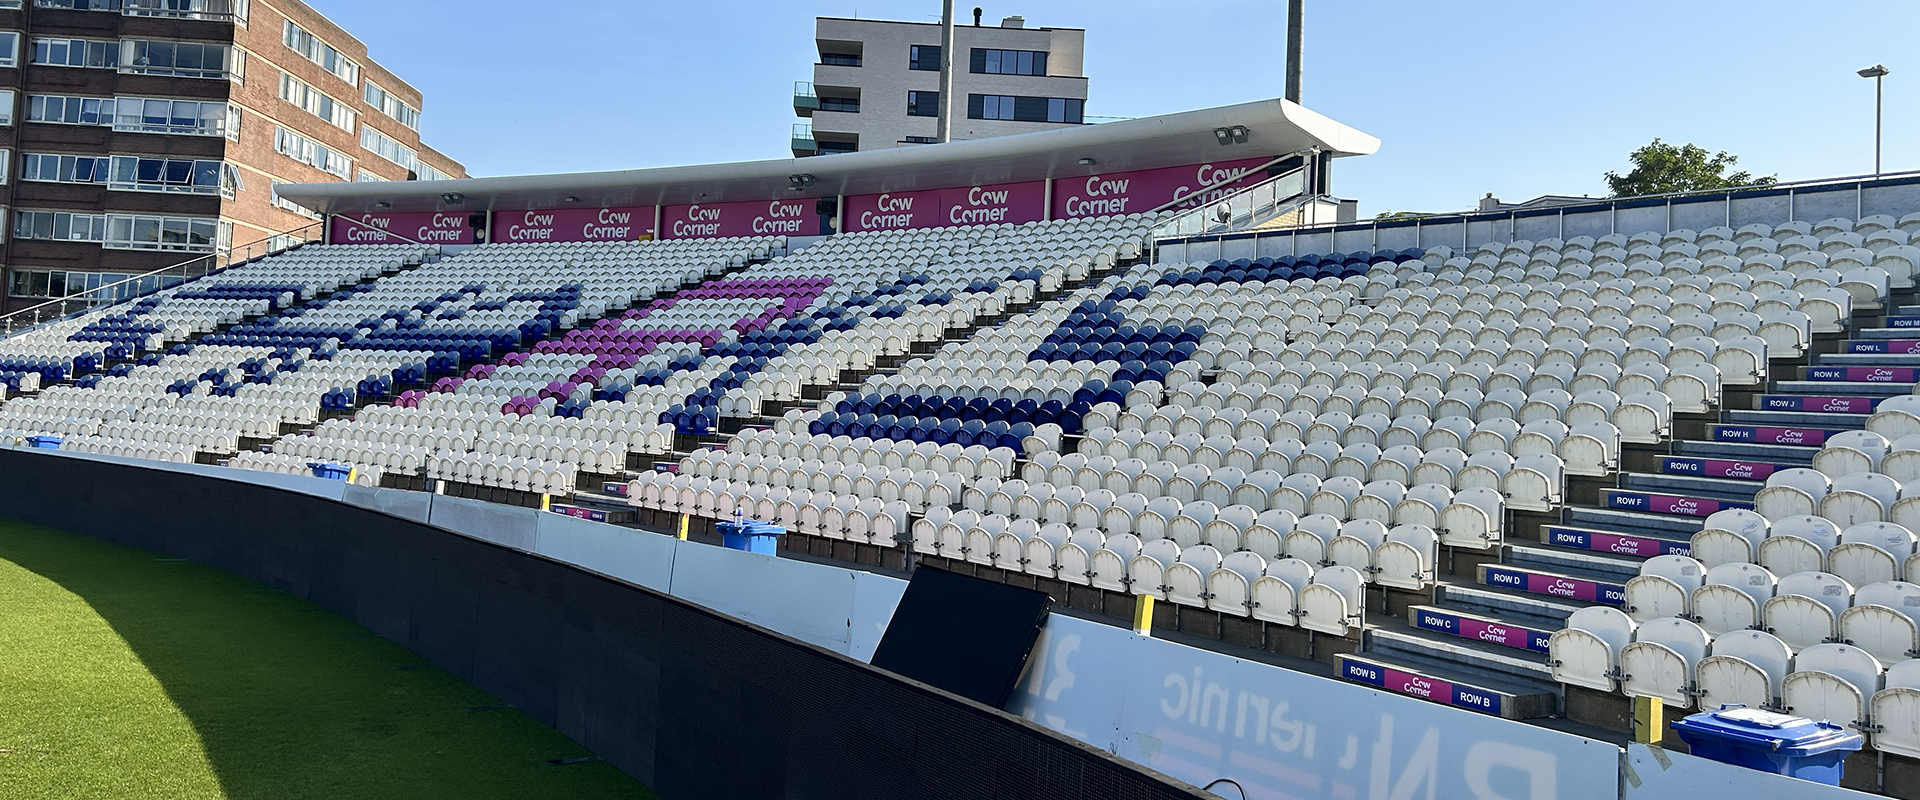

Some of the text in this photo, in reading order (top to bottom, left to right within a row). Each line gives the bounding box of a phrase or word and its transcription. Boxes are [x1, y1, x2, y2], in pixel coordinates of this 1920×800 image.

[1086, 176, 1130, 197] Cow
[968, 186, 1008, 206] Cow
[769, 201, 803, 218] Cow
[878, 194, 913, 212] Cow
[1066, 196, 1129, 216] Corner
[524, 211, 554, 226] Cow
[598, 208, 631, 225] Cow
[688, 204, 721, 222] Cow
[950, 205, 1008, 224] Corner
[361, 214, 390, 229] Cow
[432, 213, 463, 228] Cow
[752, 216, 803, 234] Corner
[861, 211, 913, 229] Corner
[347, 226, 388, 241] Corner
[417, 226, 462, 241] Corner
[509, 225, 553, 240] Corner
[583, 223, 630, 239] Corner
[673, 220, 721, 237] Corner
[1856, 344, 1874, 352] ROW
[1866, 374, 1893, 382] Corner
[1874, 368, 1893, 376] Cow
[1790, 400, 1795, 408] J
[1823, 404, 1850, 412] Corner
[1831, 398, 1850, 406] Cow
[1776, 435, 1803, 444] Corner
[1784, 429, 1803, 438] Cow
[1670, 462, 1689, 470] ROW
[1733, 463, 1753, 472] Cow
[1725, 469, 1753, 478] Corner
[1616, 496, 1642, 506] ROW F
[1678, 499, 1698, 508] Cow
[1670, 504, 1698, 514] Corner
[1557, 533, 1583, 544] ROW E
[1619, 537, 1638, 547] Cow
[1611, 543, 1638, 554] Corner
[1669, 547, 1690, 556] ROW
[1494, 573, 1520, 585] ROW D
[1556, 579, 1576, 589] Cow
[1548, 584, 1576, 597] Corner
[1425, 616, 1451, 628] ROW C
[1479, 630, 1506, 643] Corner
[1487, 624, 1506, 636] Cow
[1350, 665, 1376, 680] ROW B
[1412, 676, 1431, 689] Cow
[1403, 683, 1431, 697] Corner
[1460, 691, 1490, 707] ROW B
